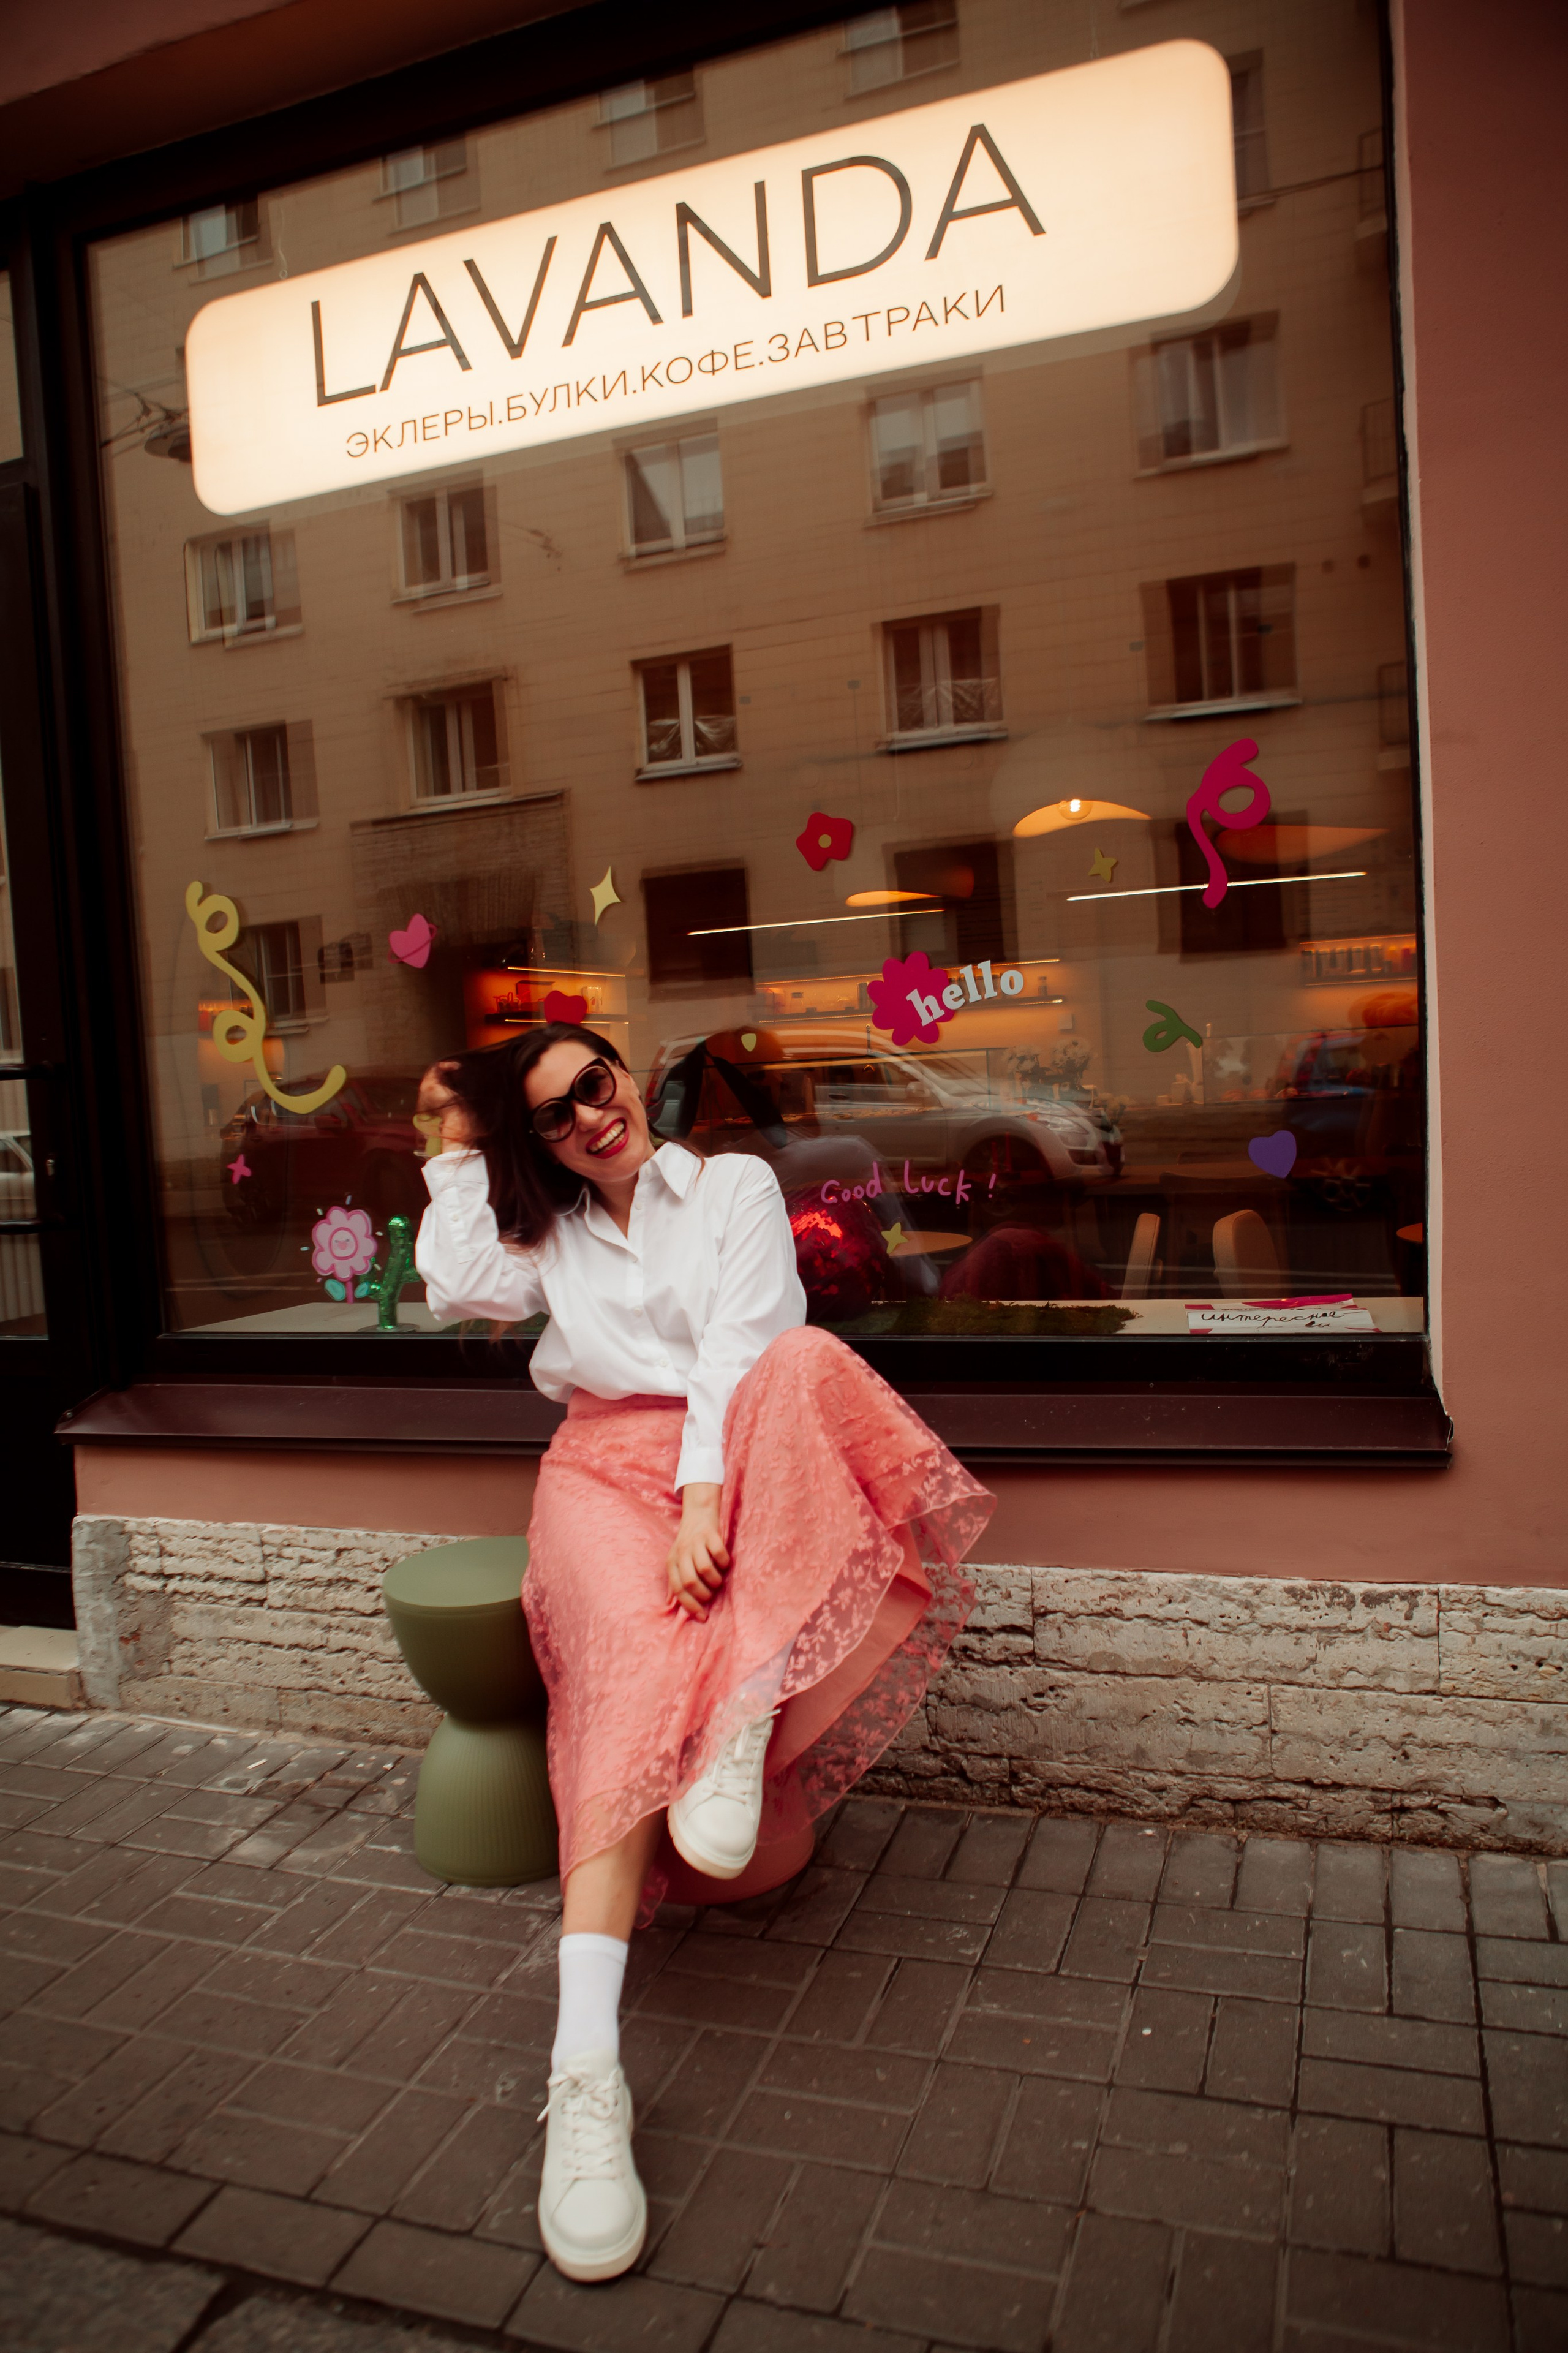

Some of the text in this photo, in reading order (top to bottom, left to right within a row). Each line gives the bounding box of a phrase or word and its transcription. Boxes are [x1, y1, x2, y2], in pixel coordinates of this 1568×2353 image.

[311, 123, 1046, 407] LAVANDA
[906, 959, 1024, 1026] hello
[820, 1161, 883, 1204] Good
